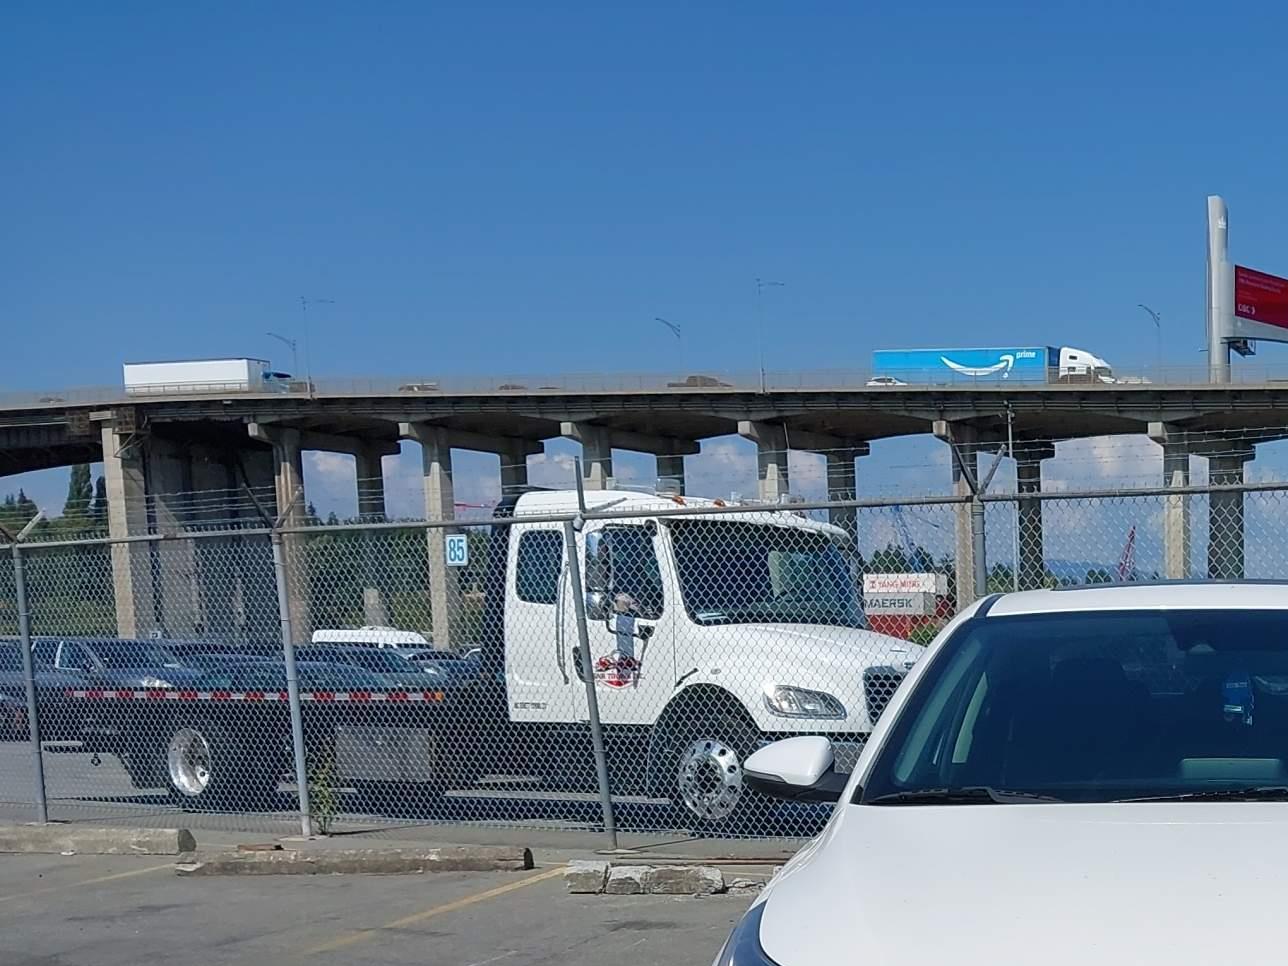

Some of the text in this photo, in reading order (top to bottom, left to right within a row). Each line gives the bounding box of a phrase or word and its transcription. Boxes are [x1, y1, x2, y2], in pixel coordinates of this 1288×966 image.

[1015, 350, 1036, 359] prime
[448, 538, 465, 562] 85
[864, 598, 913, 609] MAERSK
